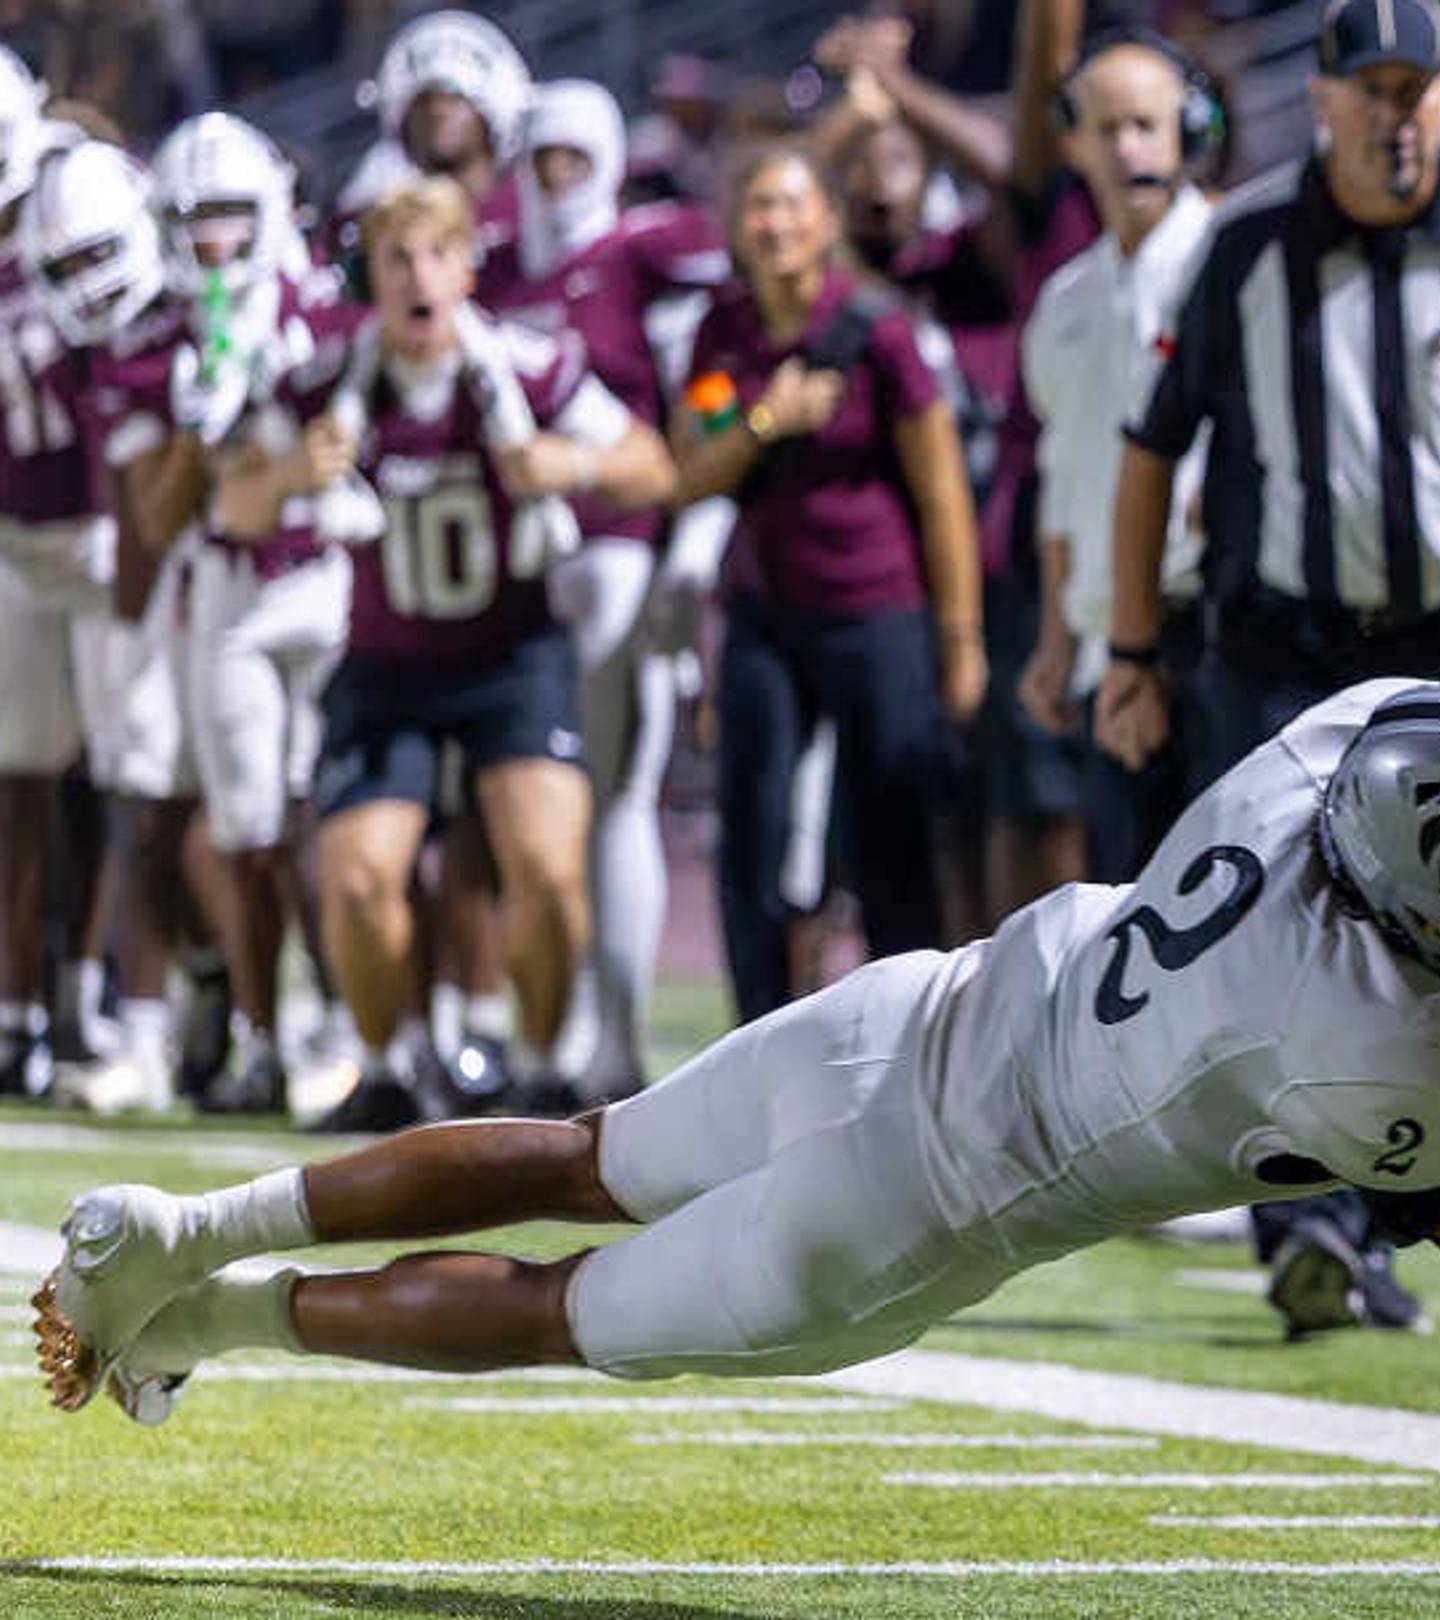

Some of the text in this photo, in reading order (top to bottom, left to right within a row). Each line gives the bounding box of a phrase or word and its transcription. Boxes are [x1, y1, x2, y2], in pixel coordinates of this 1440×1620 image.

[383, 484, 497, 620] 10
[1095, 846, 1265, 1025] 2
[1374, 1117, 1424, 1176] 2
